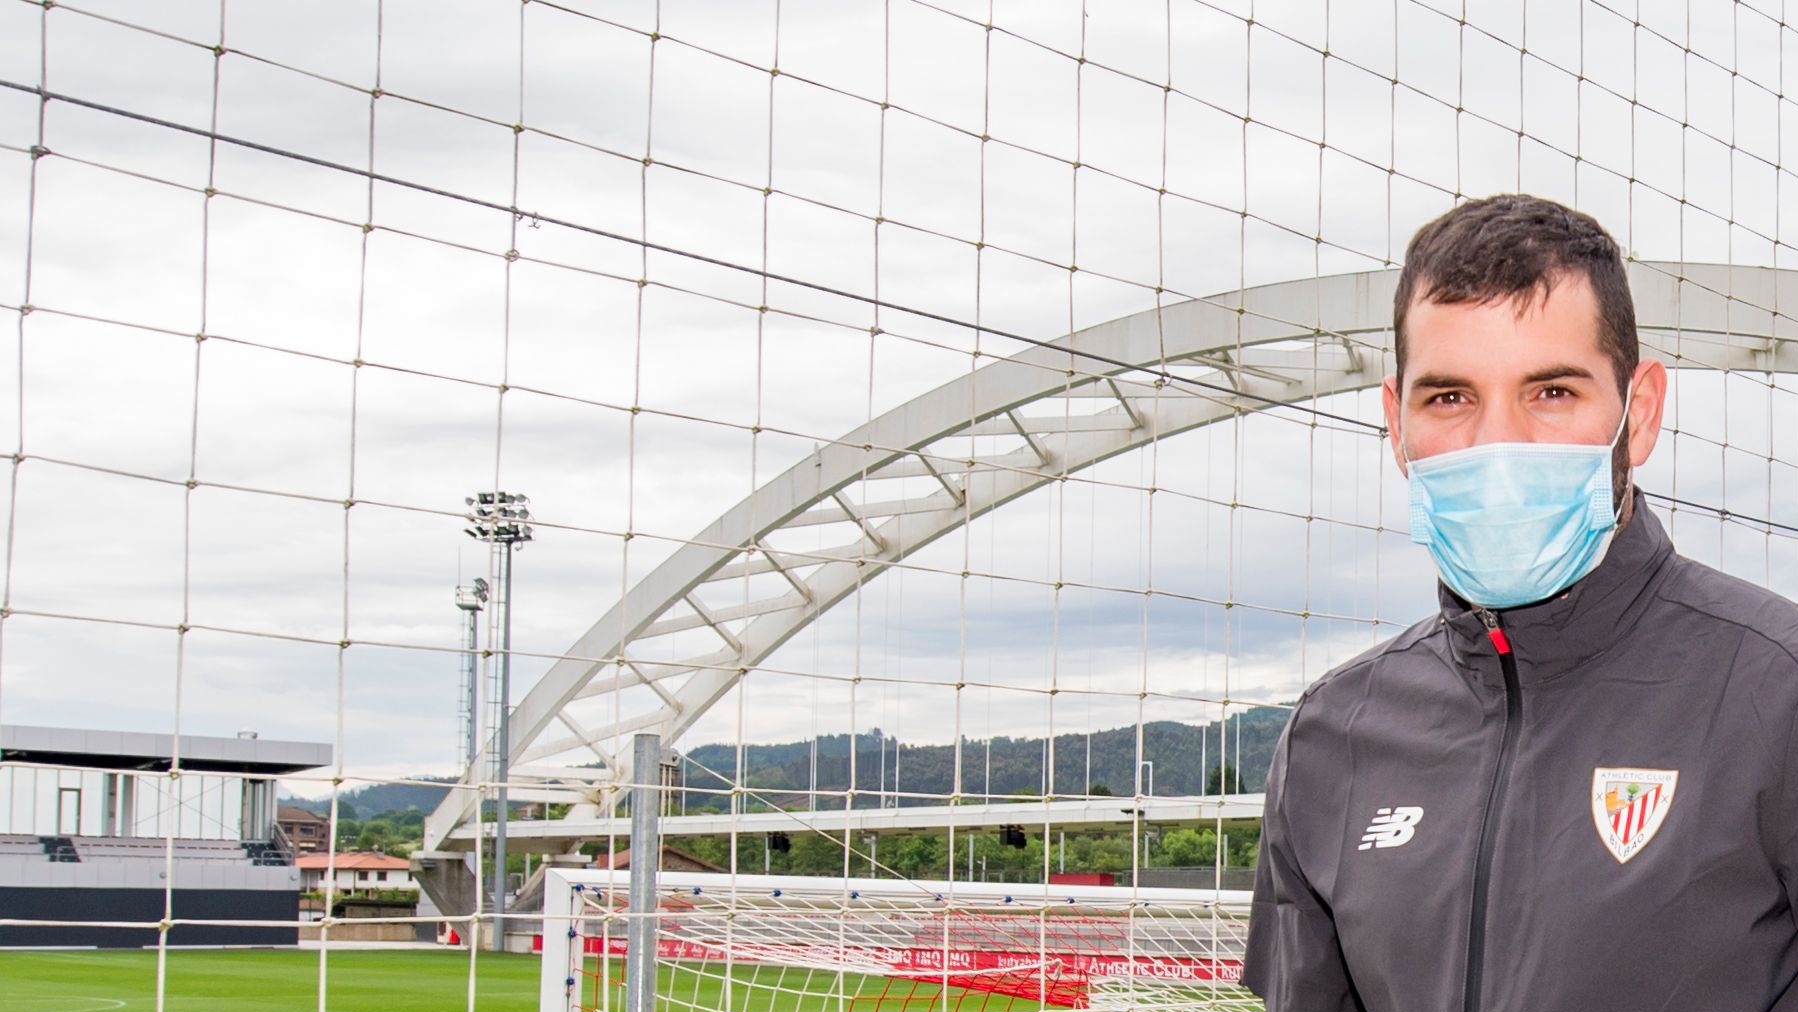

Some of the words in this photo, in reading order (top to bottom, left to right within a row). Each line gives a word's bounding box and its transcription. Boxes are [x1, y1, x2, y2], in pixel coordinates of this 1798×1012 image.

[1609, 833, 1644, 858] BILBAO
[944, 952, 971, 968] MQ
[1089, 957, 1149, 976] ATHLEIC
